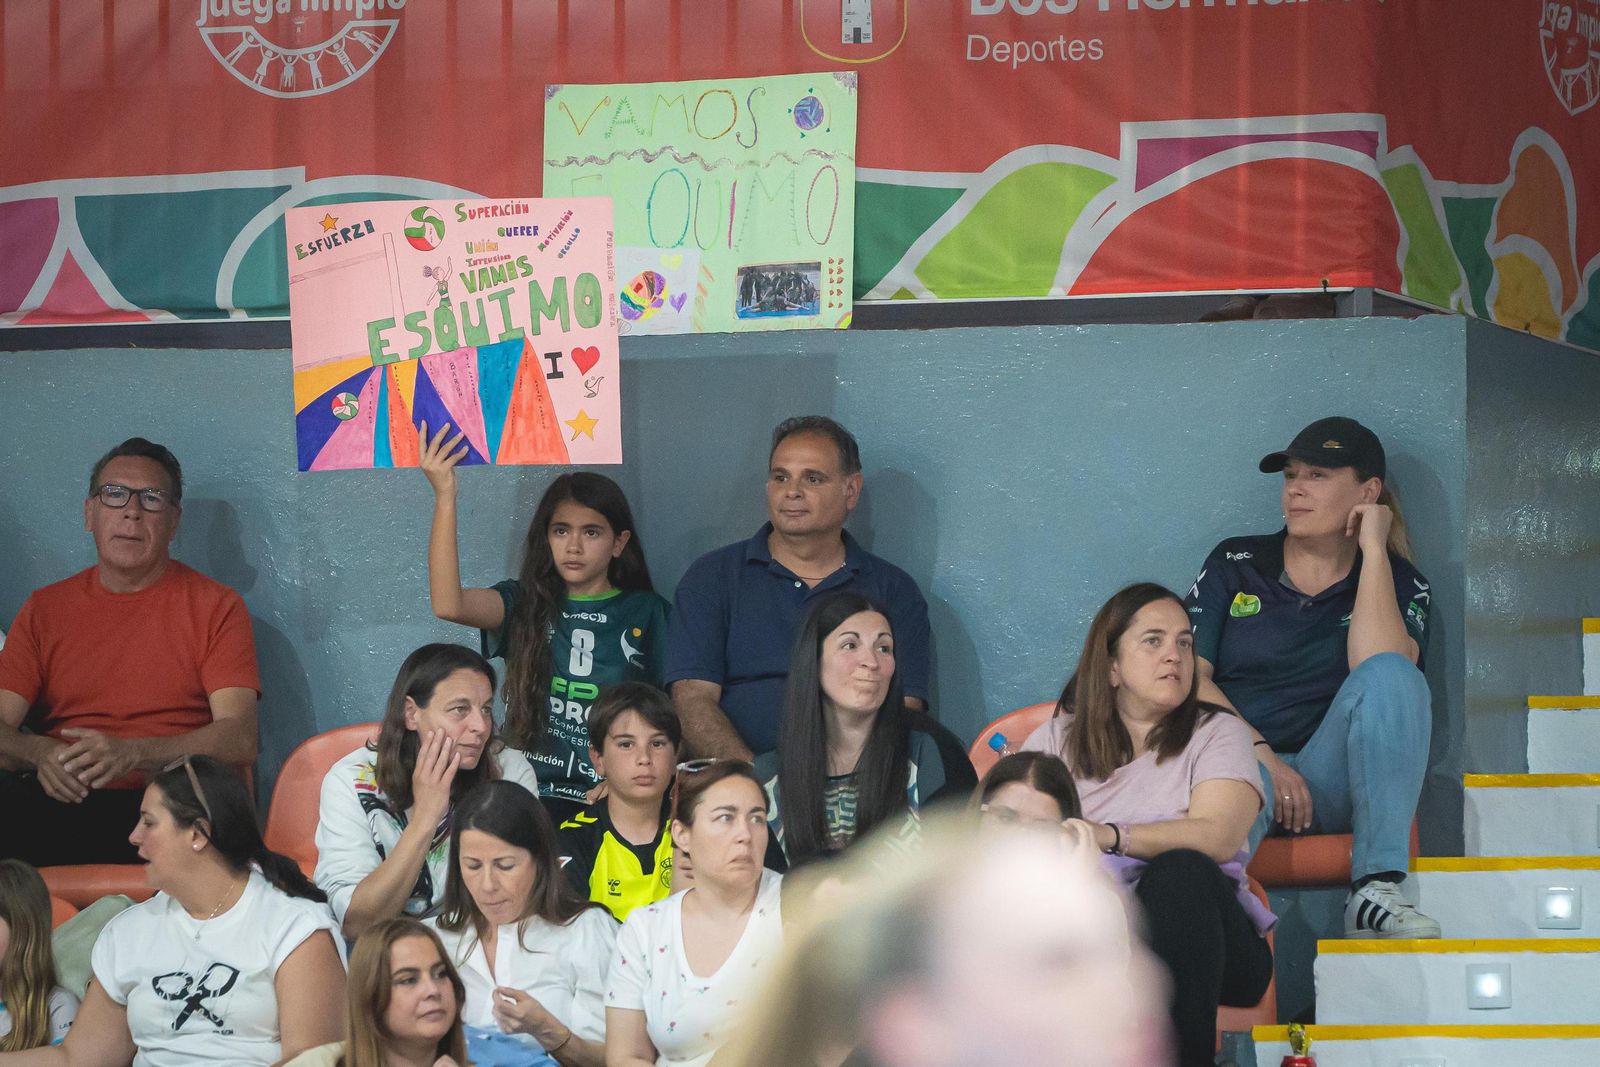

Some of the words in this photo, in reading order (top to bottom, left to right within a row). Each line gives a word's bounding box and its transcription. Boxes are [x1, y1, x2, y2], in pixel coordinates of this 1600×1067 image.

[966, 34, 1104, 69] Deportes
[558, 87, 767, 149] VAMOS
[497, 225, 539, 238] QUERER
[459, 255, 534, 294] VAMOS
[367, 272, 603, 366] ESQUIMO
[544, 351, 565, 380] I
[569, 628, 595, 677] 8
[551, 676, 599, 700] FP
